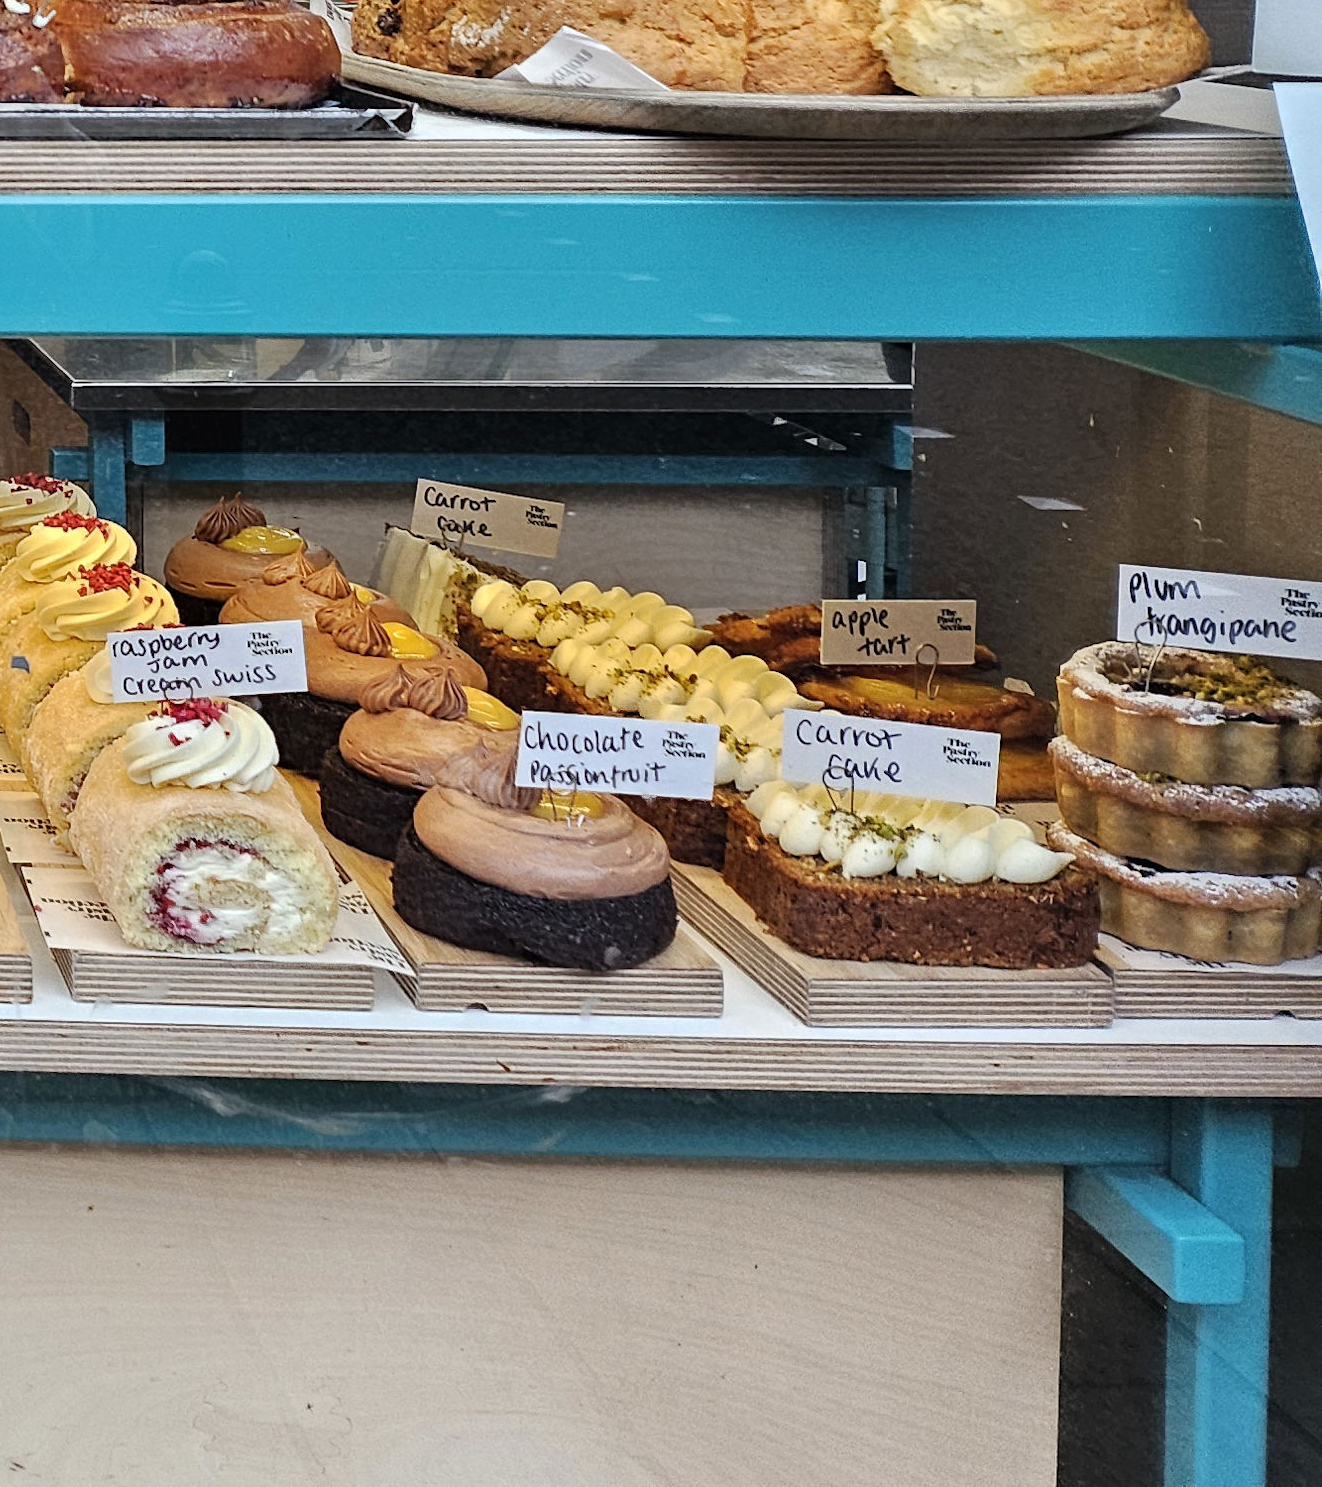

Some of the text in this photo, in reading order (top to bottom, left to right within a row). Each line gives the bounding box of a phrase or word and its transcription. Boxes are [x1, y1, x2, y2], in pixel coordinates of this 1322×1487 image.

[424, 486, 496, 512] Carrot
[1285, 588, 1310, 599] The
[1281, 597, 1320, 609] Pastry
[941, 608, 957, 617] The
[1285, 607, 1322, 618] Sectio
[832, 607, 889, 636] apple
[939, 624, 972, 632] Section
[113, 631, 221, 659] raspberry
[857, 633, 911, 657] tart
[947, 738, 971, 748] The
[943, 746, 982, 758] Pastry
[946, 755, 992, 768] Section
